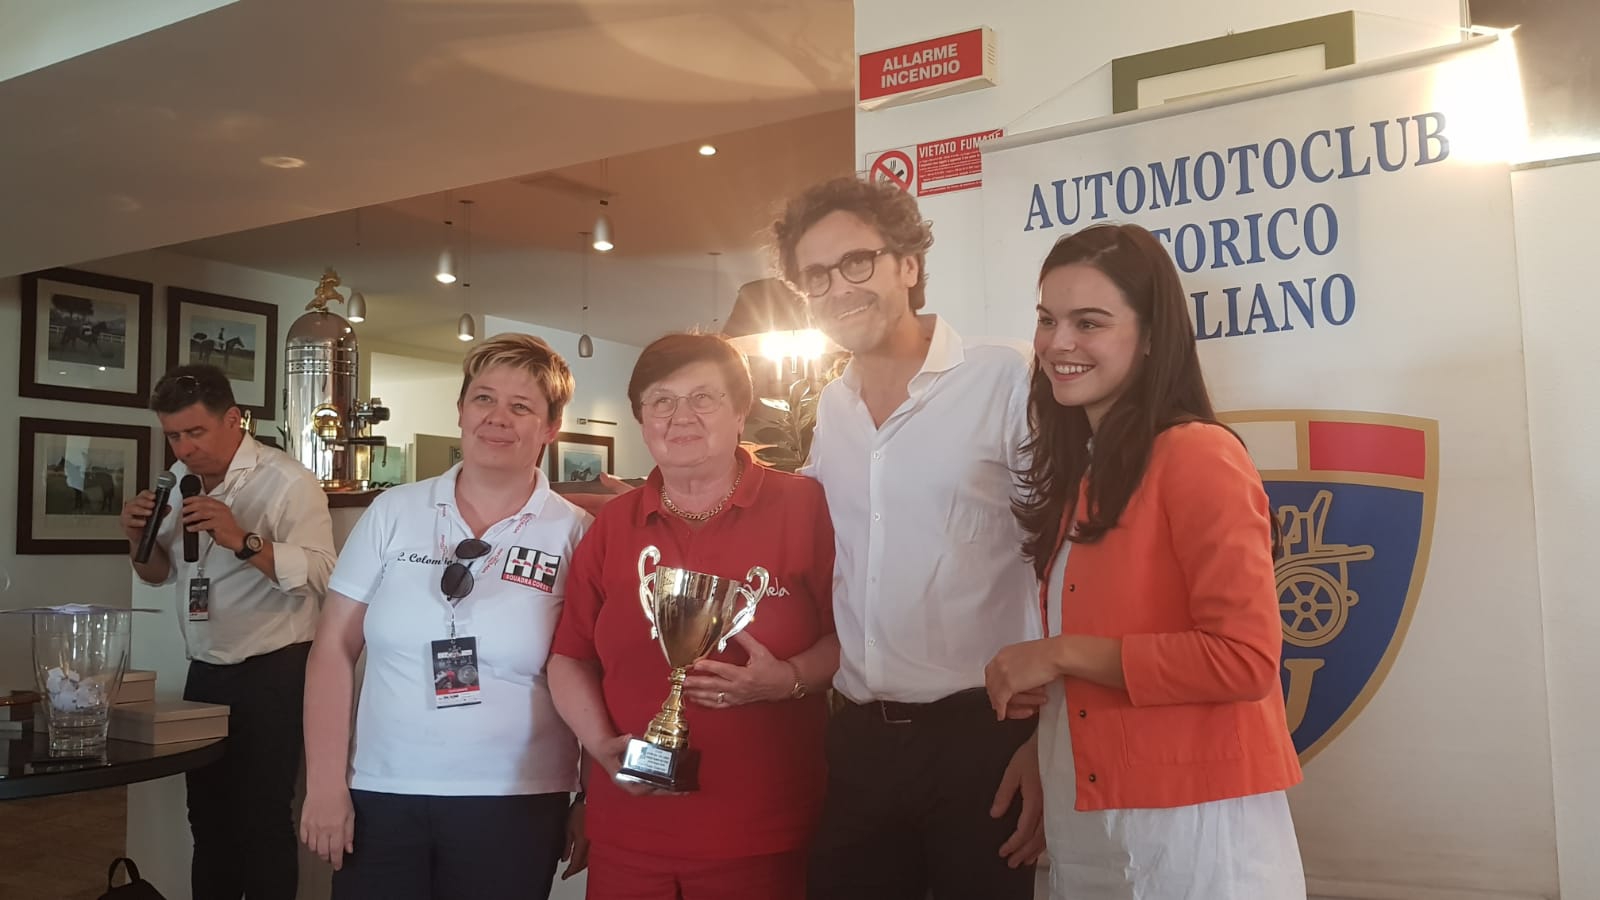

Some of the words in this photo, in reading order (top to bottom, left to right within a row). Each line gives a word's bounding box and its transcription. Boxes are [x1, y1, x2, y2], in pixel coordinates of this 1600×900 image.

[882, 43, 958, 72] ALLARME
[881, 60, 961, 88] INCENDIO
[919, 141, 957, 158] VIETATO
[1024, 111, 1450, 232] AUTOMOTOCLUB
[504, 547, 560, 581] HF
